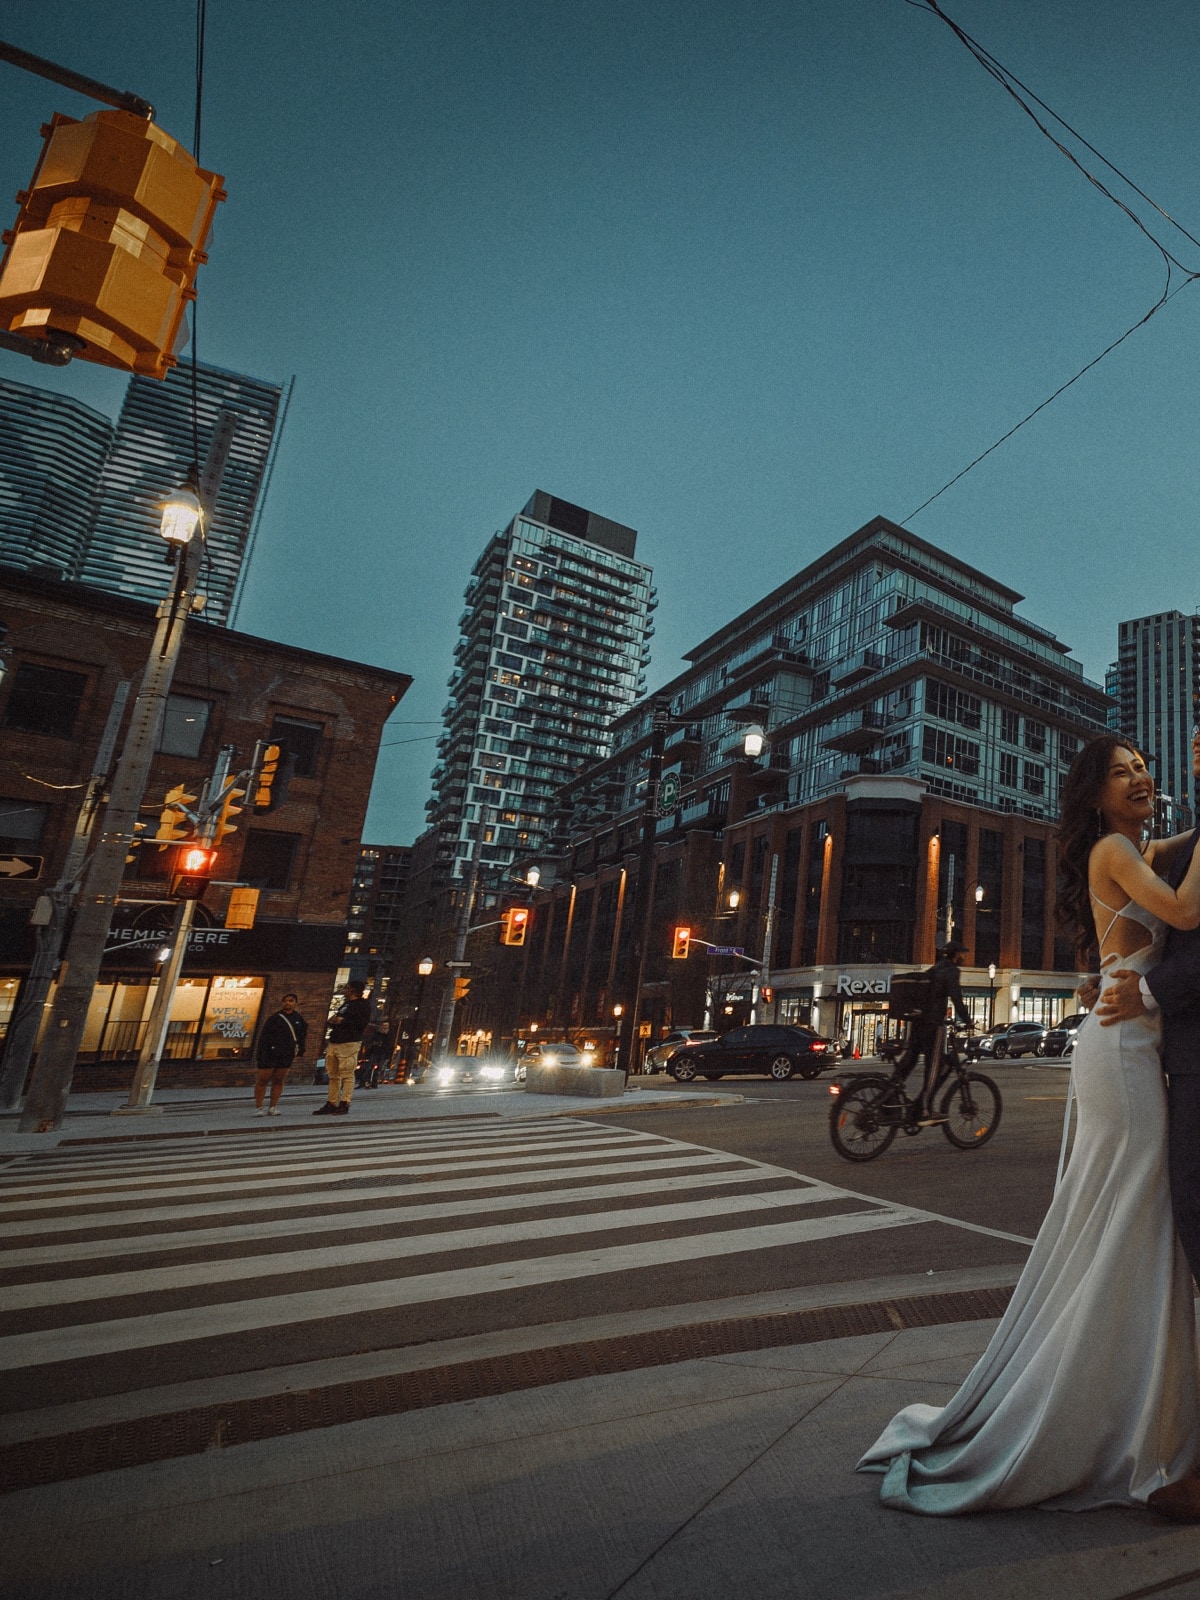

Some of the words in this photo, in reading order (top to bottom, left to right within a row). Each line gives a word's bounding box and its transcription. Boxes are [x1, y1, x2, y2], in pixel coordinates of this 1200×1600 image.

[664, 783, 675, 802] P
[106, 927, 230, 945] HEMISHERE
[836, 974, 892, 996] Rexal
[211, 1007, 247, 1015] WE'LL
[211, 1022, 244, 1031] YOUR
[222, 1030, 249, 1039] WAY.
